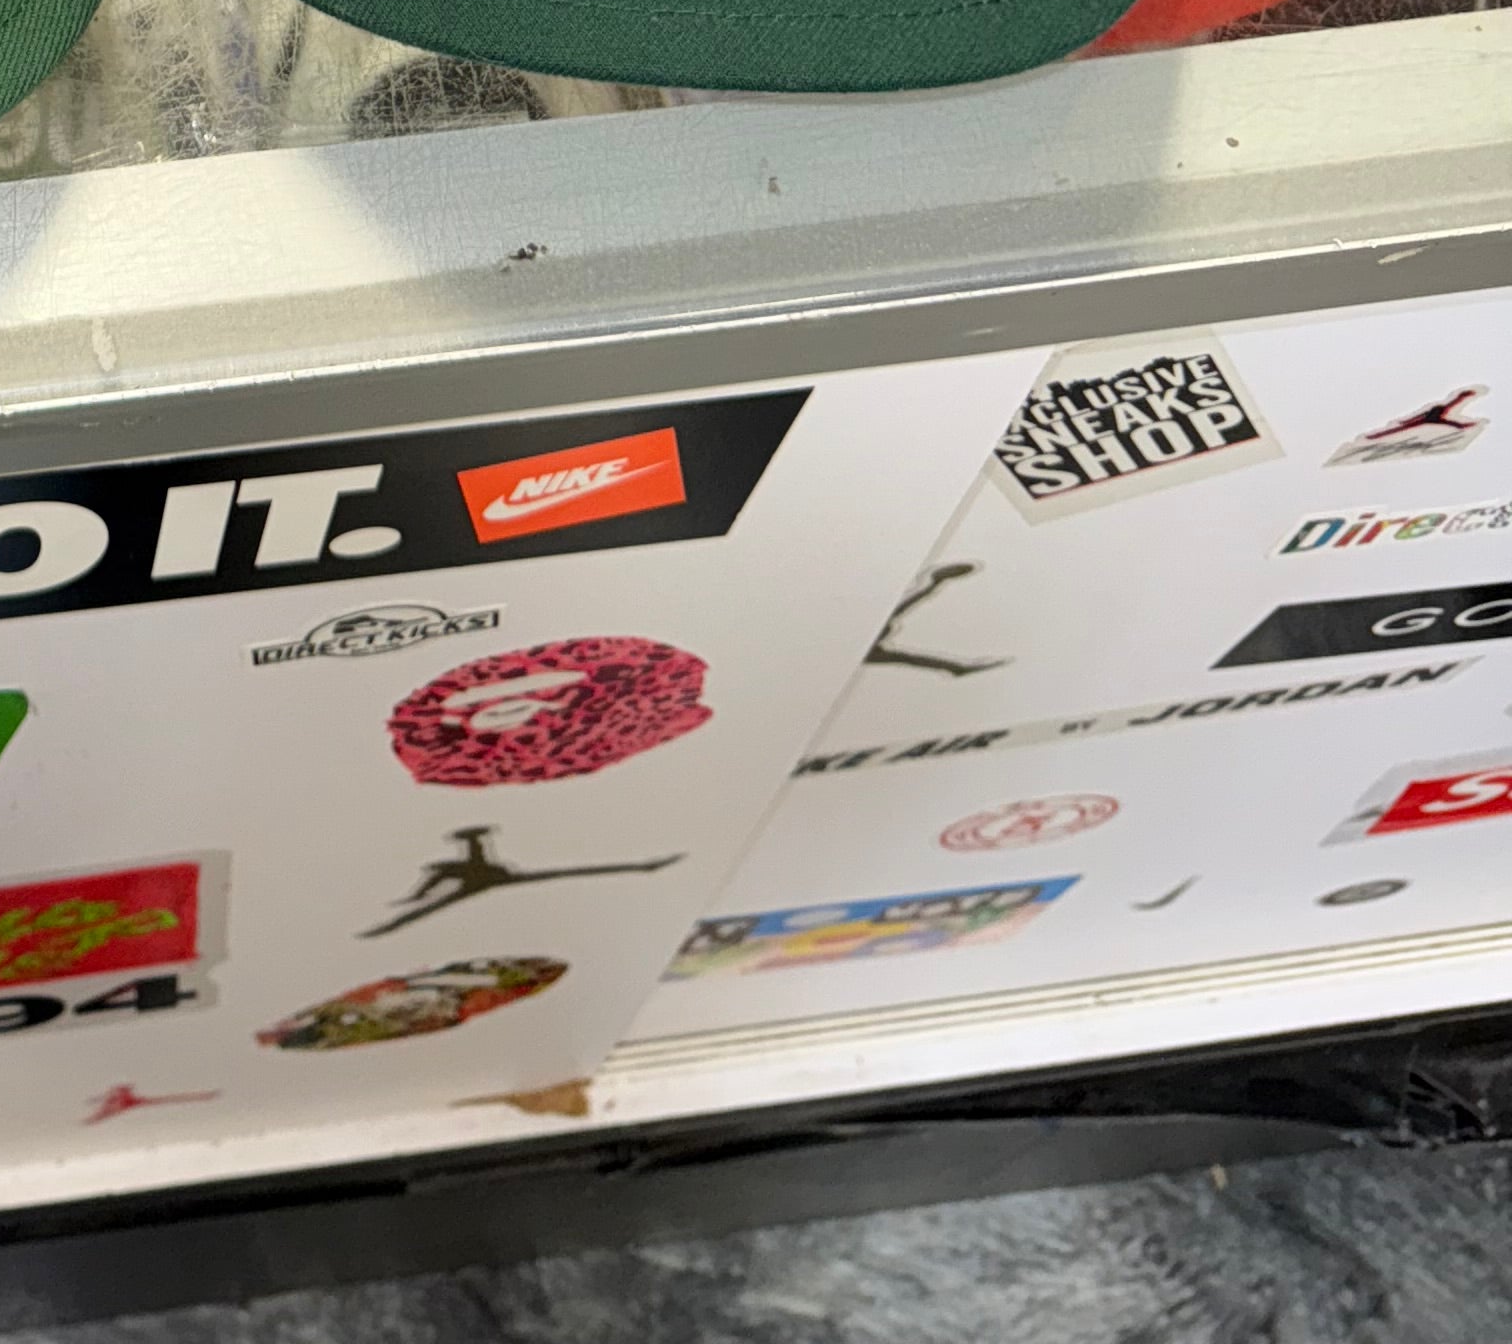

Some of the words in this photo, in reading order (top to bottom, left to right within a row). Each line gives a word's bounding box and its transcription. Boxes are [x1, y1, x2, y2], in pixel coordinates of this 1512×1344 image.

[995, 377, 1233, 464] SNEAKS
[1014, 403, 1245, 496] SHOP
[149, 463, 402, 581] IT.
[508, 457, 630, 502] NIKE
[885, 728, 1011, 764] AIR
[1127, 661, 1461, 728] JORDAN
